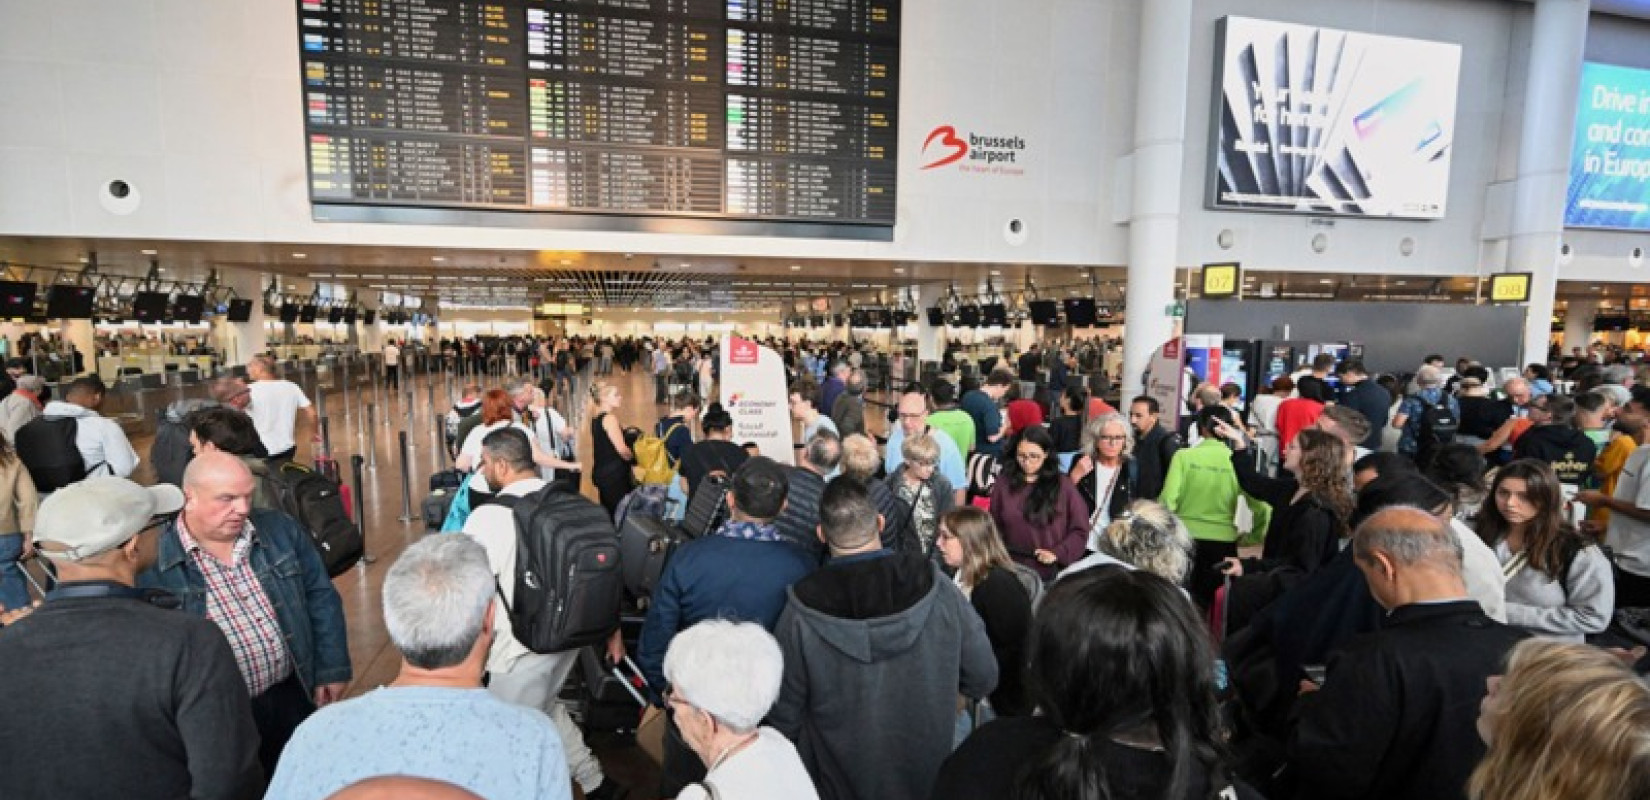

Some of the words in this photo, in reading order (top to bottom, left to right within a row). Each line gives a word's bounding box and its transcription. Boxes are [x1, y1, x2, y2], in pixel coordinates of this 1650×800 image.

[1592, 85, 1636, 112] Drive
[969, 132, 1025, 149] brussels
[1588, 117, 1622, 144] and
[969, 147, 1016, 164] airport
[1584, 148, 1601, 174] in
